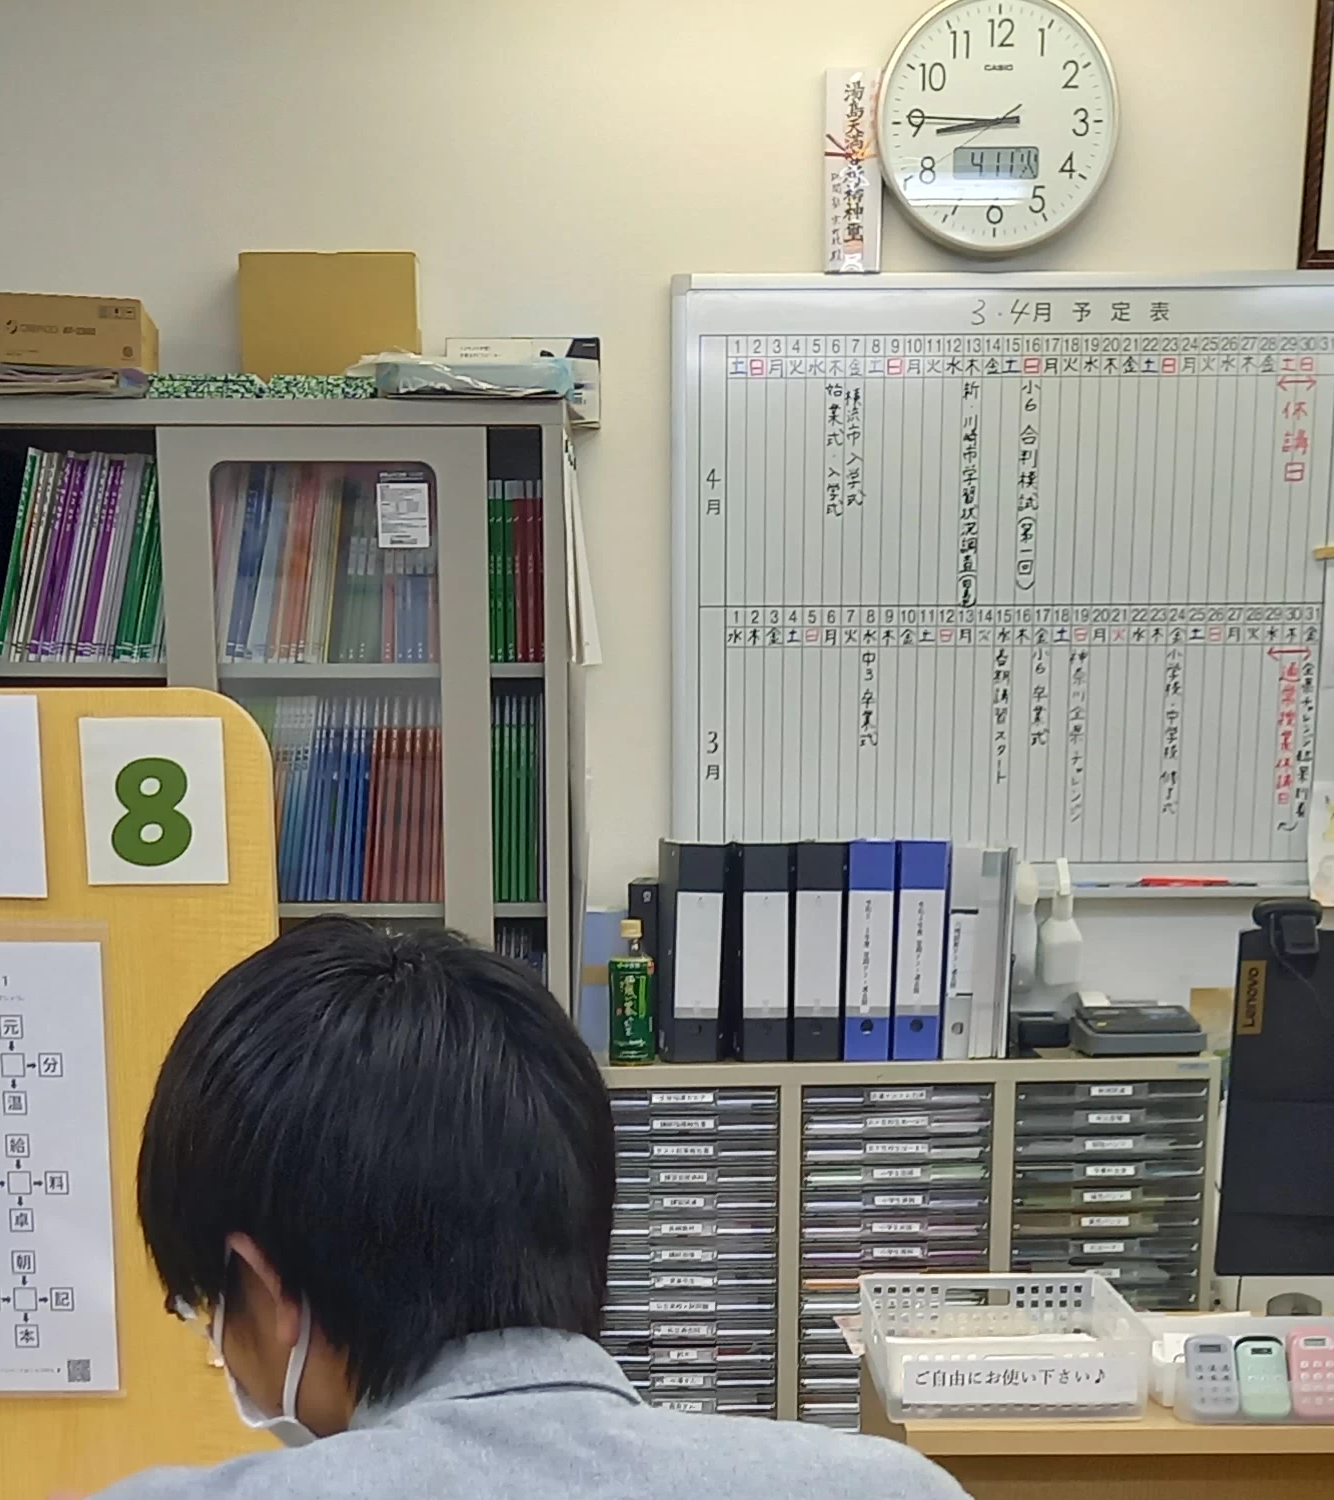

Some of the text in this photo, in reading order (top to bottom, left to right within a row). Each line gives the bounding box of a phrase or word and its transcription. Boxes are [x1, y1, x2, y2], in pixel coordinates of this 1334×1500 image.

[950, 30, 971, 59] 11
[988, 19, 1015, 47] 12
[1038, 28, 1046, 57] 1
[918, 63, 946, 92] 10
[1062, 60, 1079, 89] 2
[908, 108, 925, 138] 9
[1072, 107, 1089, 137] 3
[919, 156, 936, 184] 8
[1059, 152, 1076, 179] 4
[1029, 186, 1046, 213] 5
[733, 340, 741, 354] 1
[753, 340, 761, 353] 2
[773, 340, 781, 353] 3
[792, 340, 801, 353] 4
[812, 340, 820, 353] 5
[832, 340, 840, 353] 6
[851, 339, 860, 353] 7
[871, 339, 879, 353] 8
[891, 339, 899, 353] 9
[906, 339, 923, 353] 10
[926, 339, 943, 352] 11
[946, 339, 962, 352] 12
[965, 339, 982, 352] 13
[985, 339, 1002, 352] 14
[1005, 339, 1021, 352] 15
[1025, 338, 1041, 352] 16
[1044, 338, 1061, 352] 17
[1064, 338, 1081, 352] 18
[1084, 338, 1100, 352] 19
[1103, 338, 1120, 351] 20
[1123, 338, 1140, 351] 21
[1143, 338, 1159, 351] 22
[1162, 338, 1179, 351] 23
[1182, 338, 1199, 351] 24
[1202, 337, 1218, 351] 25
[1221, 337, 1238, 351] 26
[1241, 337, 1258, 351] 27
[1261, 337, 1278, 351] 28
[1281, 337, 1297, 350] 29
[1300, 337, 1317, 350] 30
[1282, 401, 1310, 482] 休講日
[111, 757, 192, 866] 8
[1241, 967, 1259, 1028] Lenovo
[4, 1020, 19, 1035] 元
[43, 1058, 58, 1073] 分
[17, 1255, 31, 1270] 朝
[55, 1292, 70, 1306] 記
